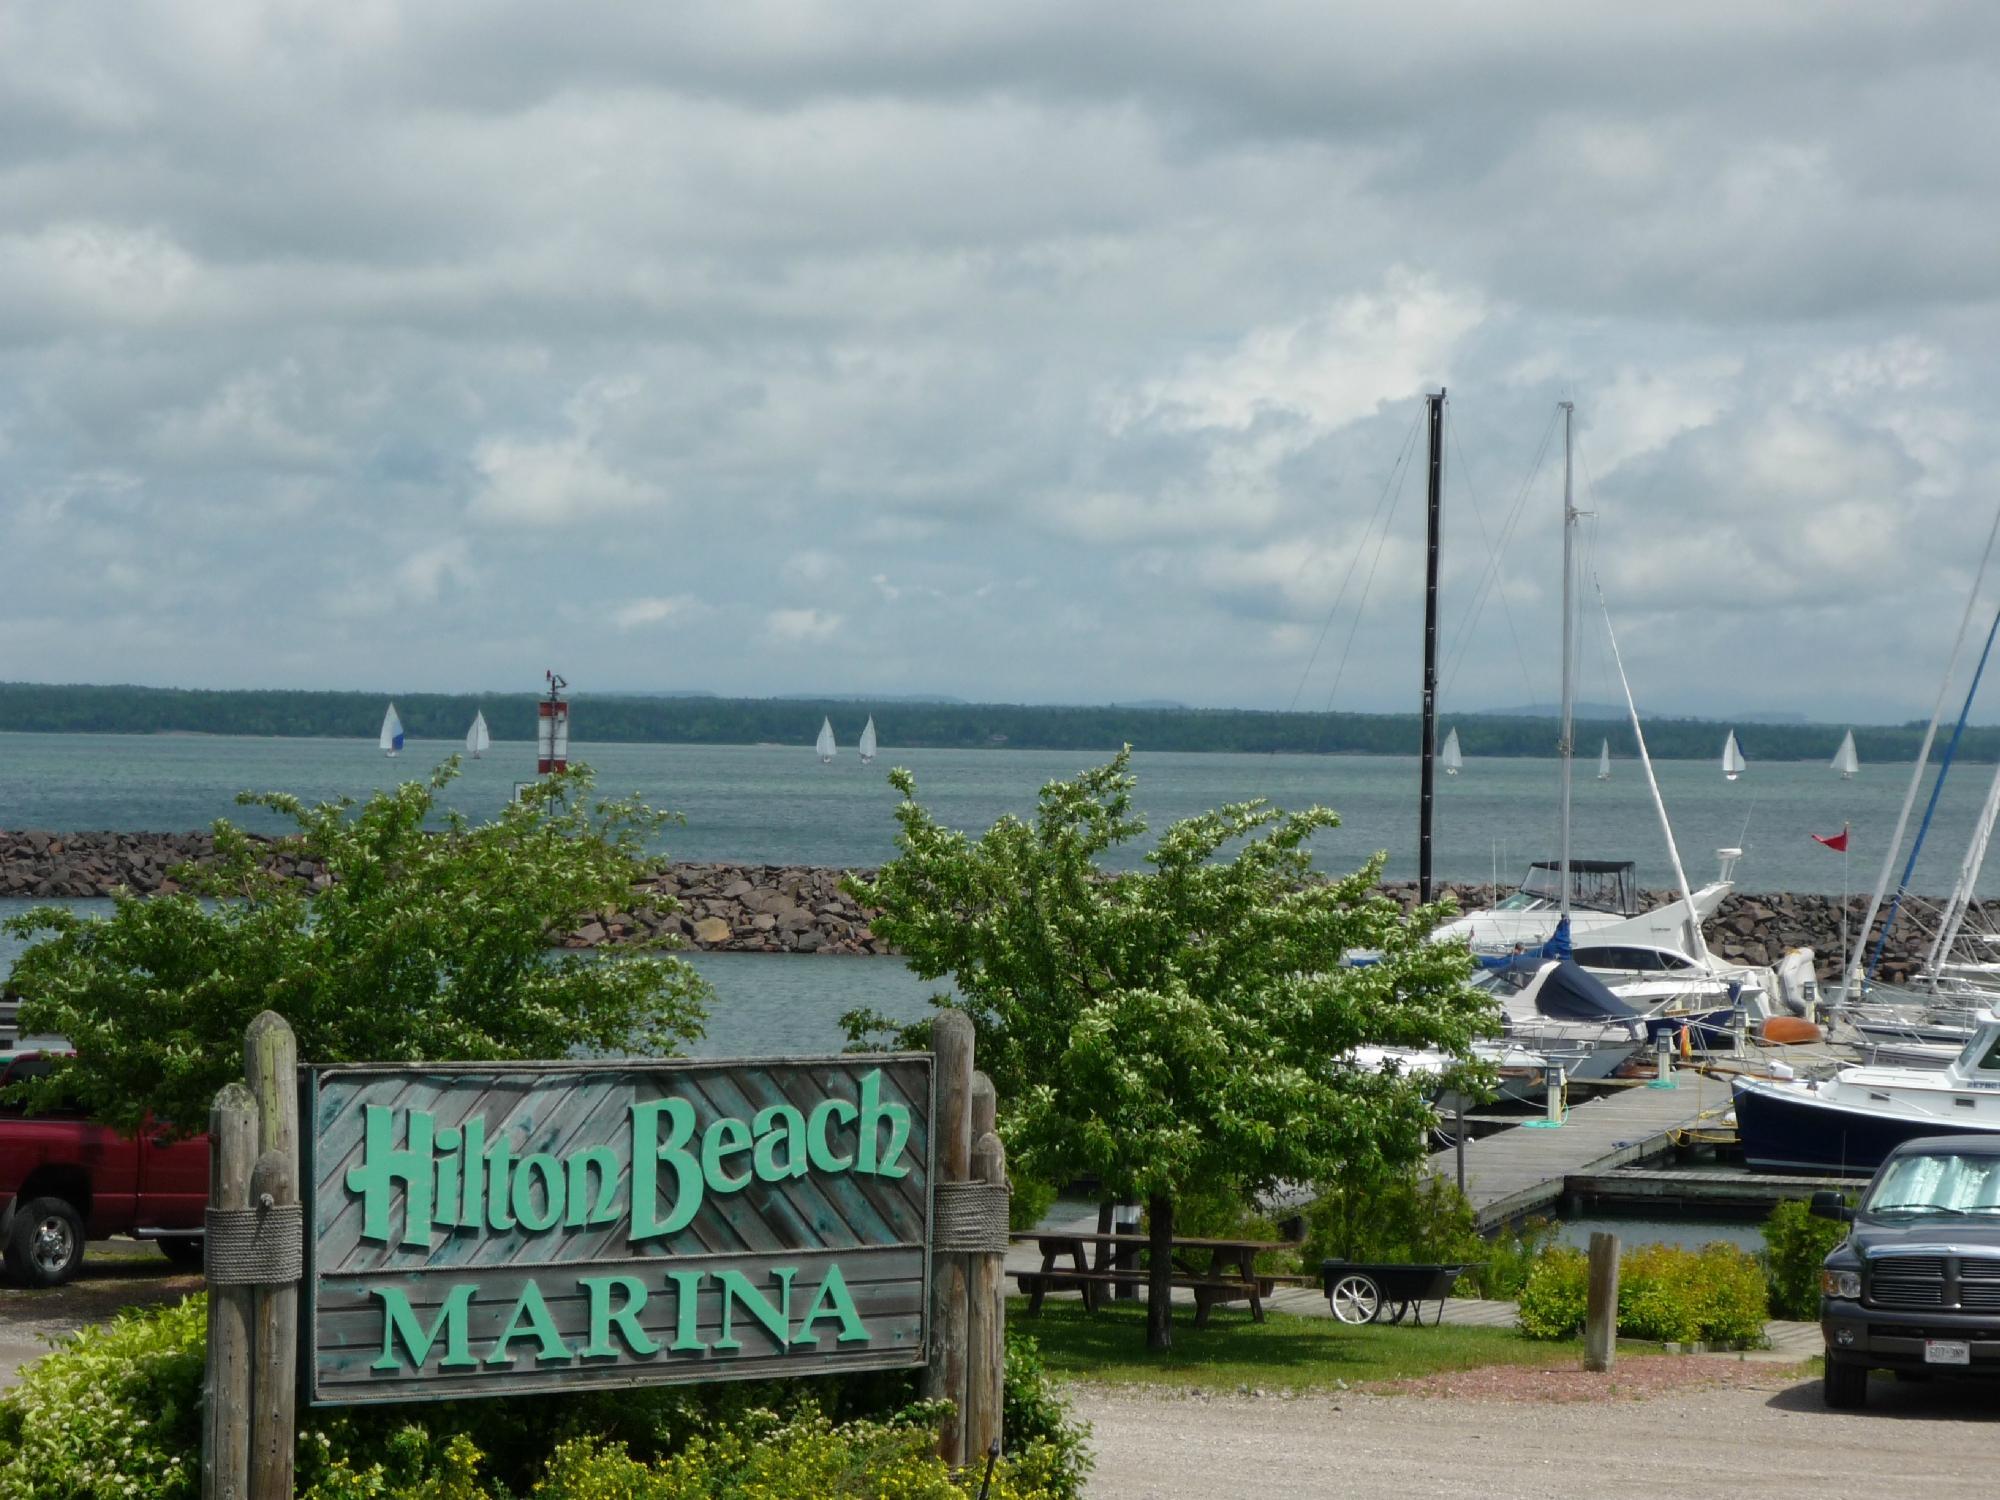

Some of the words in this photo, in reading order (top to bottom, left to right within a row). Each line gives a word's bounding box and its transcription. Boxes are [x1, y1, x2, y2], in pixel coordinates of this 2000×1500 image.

[346, 1104, 620, 1247] Hilton
[629, 1068, 911, 1242] Beach
[370, 1263, 871, 1370] MARINA
